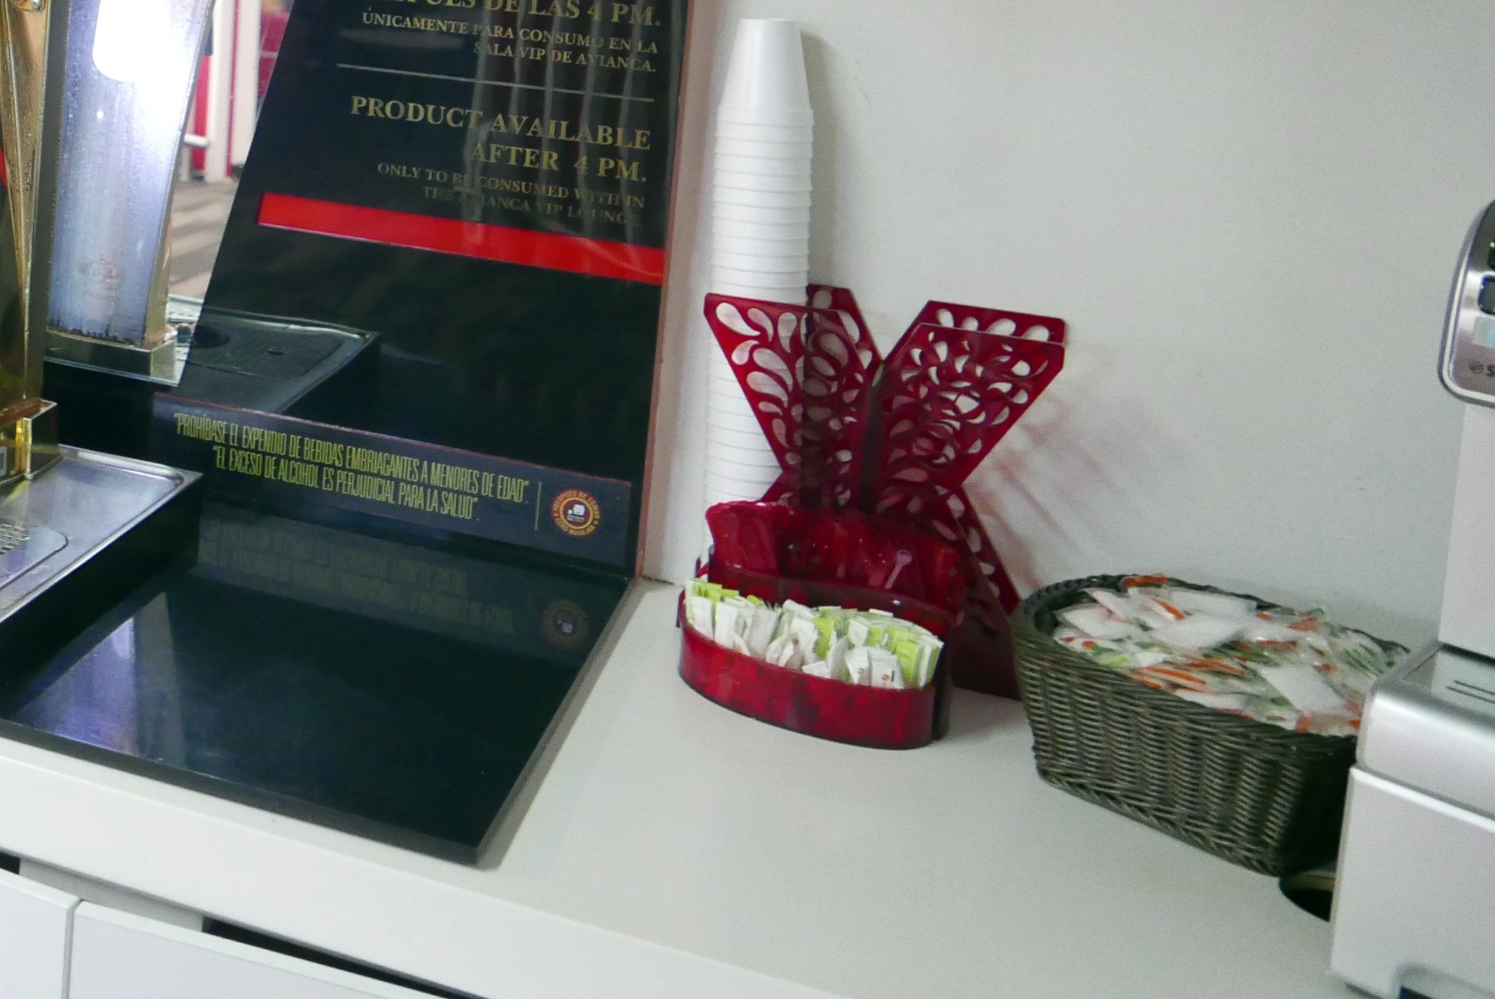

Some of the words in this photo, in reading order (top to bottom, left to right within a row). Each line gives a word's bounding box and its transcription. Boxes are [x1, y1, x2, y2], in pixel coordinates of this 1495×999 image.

[362, 7, 468, 34] ÚNICAMENTE
[473, 21, 515, 40] PARA
[519, 28, 603, 48] CONSUMO
[608, 37, 632, 51] EN
[637, 40, 658, 54] LA
[587, 3, 602, 21] 4
[474, 41, 513, 57] SALA
[519, 47, 546, 61] VIP
[550, 50, 572, 64] DE
[350, 95, 484, 130] PRODUCT
[490, 113, 651, 150] AVAILABLE
[471, 143, 559, 171] AFTER
[574, 155, 589, 175] 4
[377, 163, 421, 180] ONLY
[425, 168, 448, 183] TO
[479, 175, 569, 199] CONSUMED
[229, 423, 239, 447] EL
[242, 425, 287, 456] EXPENDIO
[289, 435, 301, 458] DE
[304, 437, 344, 467] BEBIDAS
[345, 445, 420, 482] EMBRIAGANTES
[420, 461, 429, 484] A
[430, 462, 480, 494] MENORES
[481, 471, 495, 498] DE
[229, 448, 263, 477] EXCESO
[264, 455, 277, 480] DE
[277, 458, 319, 489] ALCOHOL
[322, 467, 334, 492] ES
[336, 470, 395, 505] PERJUDICIAL
[398, 482, 425, 511] PARA
[426, 488, 439, 513] LA
